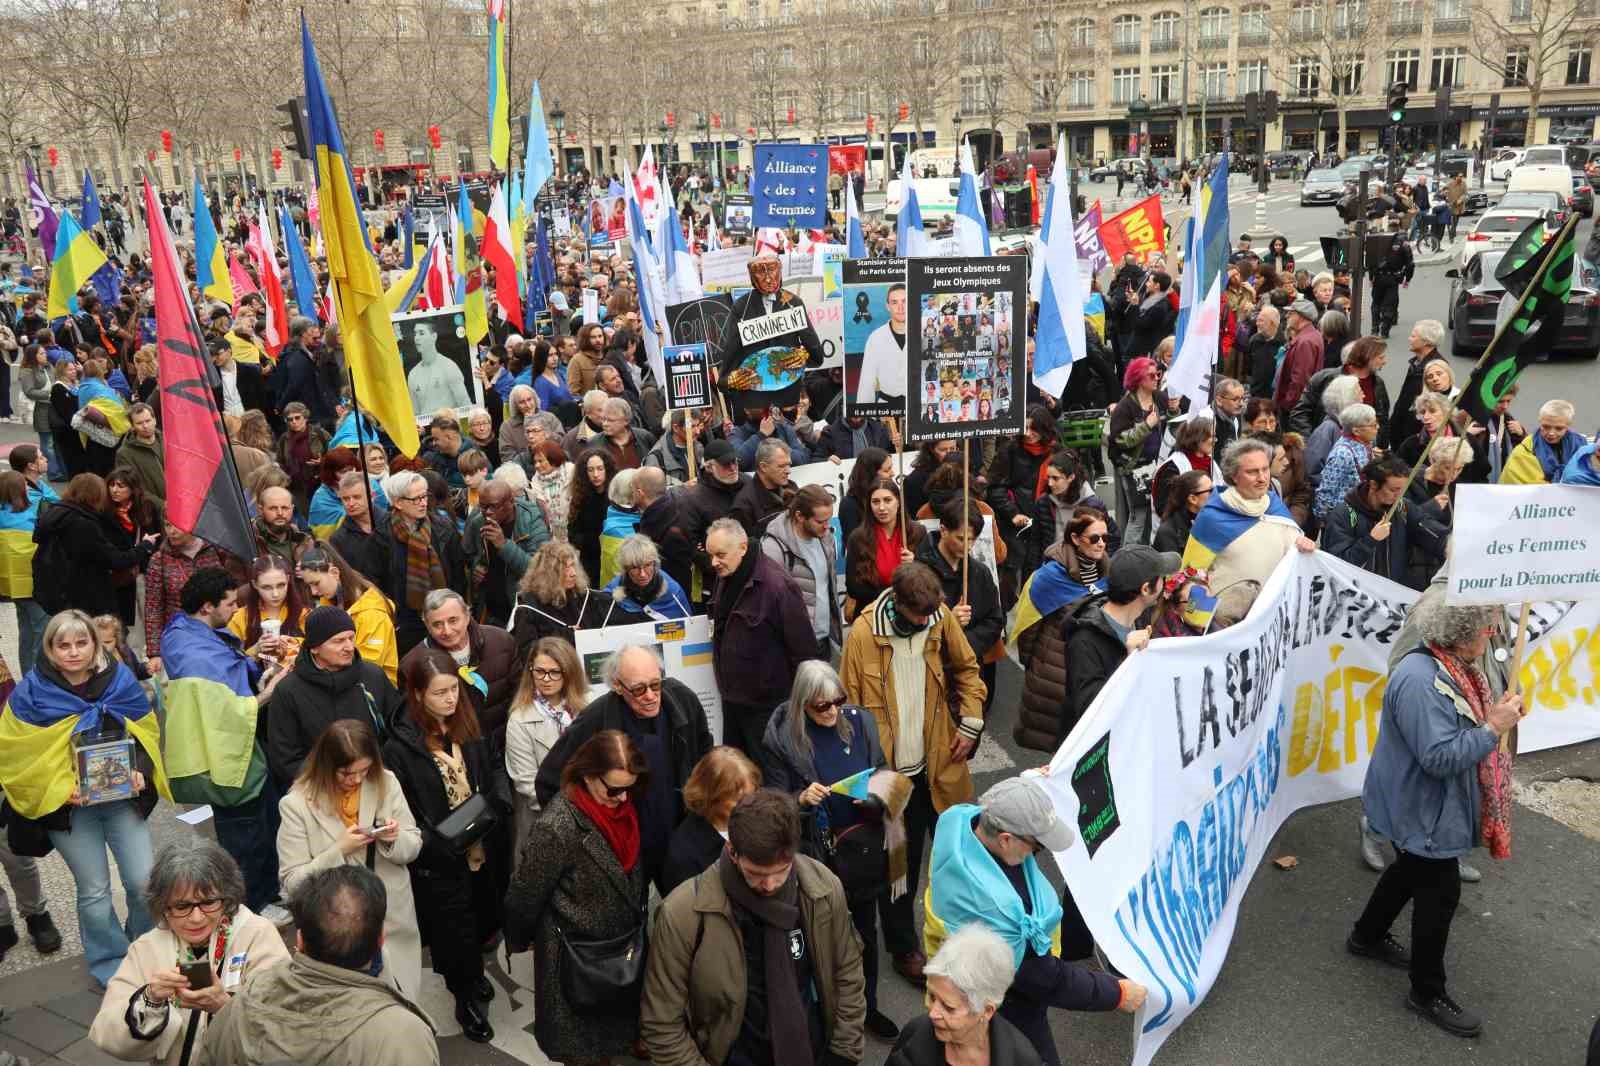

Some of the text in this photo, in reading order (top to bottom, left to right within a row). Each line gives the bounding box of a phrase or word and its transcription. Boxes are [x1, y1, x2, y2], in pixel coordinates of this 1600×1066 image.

[764, 161, 816, 173] Alliance
[775, 183, 796, 195] des
[768, 203, 816, 215] Femmes
[963, 265, 995, 273] absents
[997, 264, 1011, 272] des
[933, 278, 1001, 287] Jeux Olympiques
[934, 431, 946, 439] été
[963, 431, 975, 439] par
[1509, 503, 1576, 520] Alliance
[1487, 538, 1587, 555] des Femmes
[1458, 569, 1600, 593] pour la Démocratie
